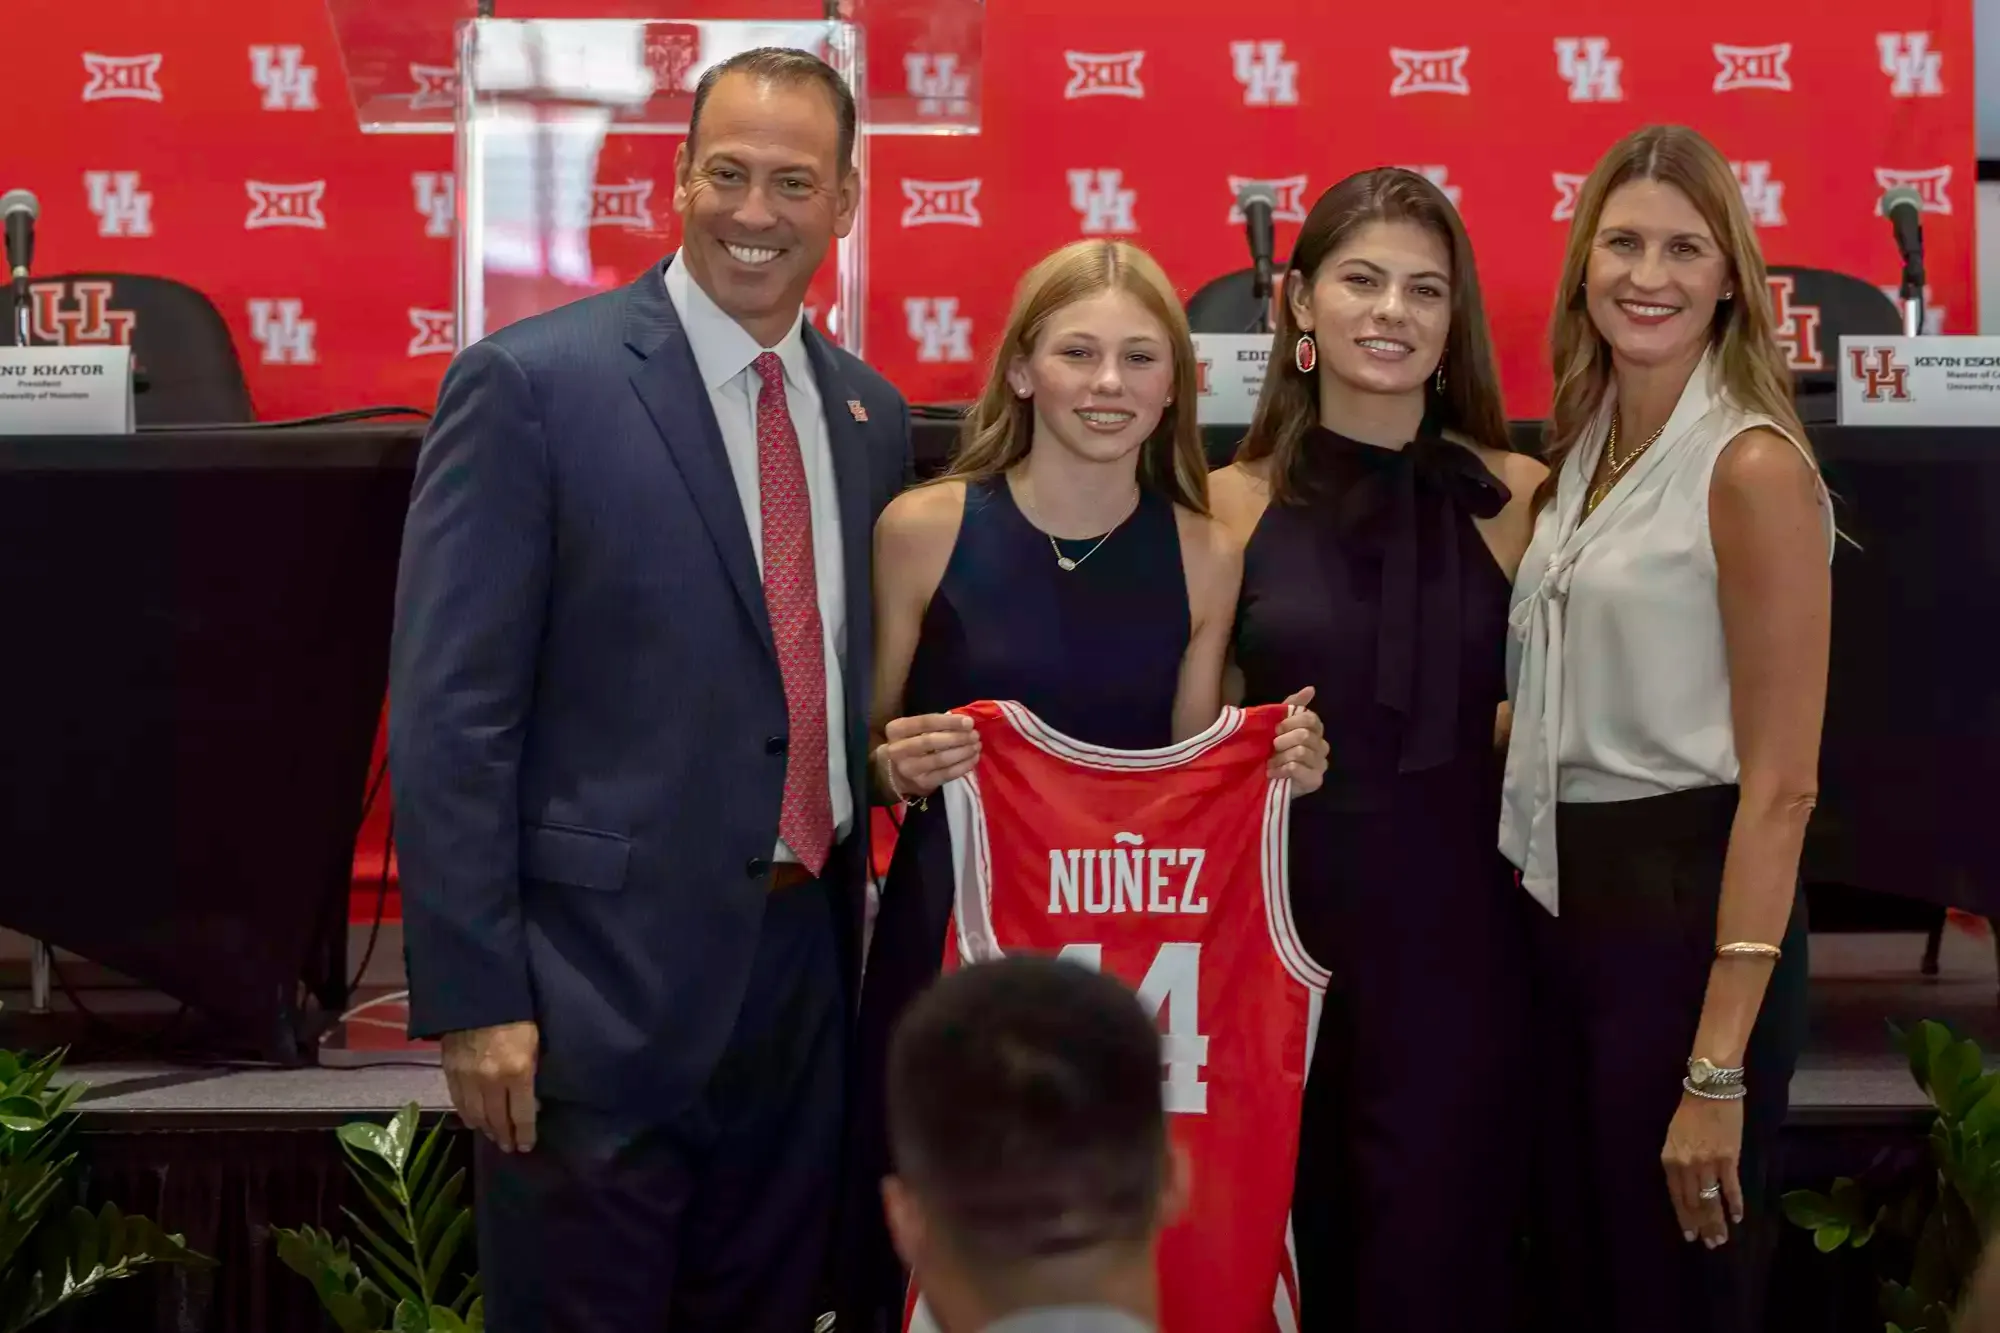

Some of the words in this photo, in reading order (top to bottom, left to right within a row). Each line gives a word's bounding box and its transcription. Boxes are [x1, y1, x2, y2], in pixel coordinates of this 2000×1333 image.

[250, 46, 316, 109] UH
[1231, 41, 1298, 104] UH
[1555, 37, 1622, 101] UH
[1876, 32, 1942, 96] UH
[86, 171, 152, 237] UH
[1068, 169, 1136, 233] UH
[249, 300, 316, 363] UH
[905, 297, 972, 361] UH
[33, 365, 104, 376] KHATOR
[1848, 347, 1911, 402] UH
[1914, 356, 1961, 367] KEVIN
[1048, 832, 1208, 914] NUÑEZ
